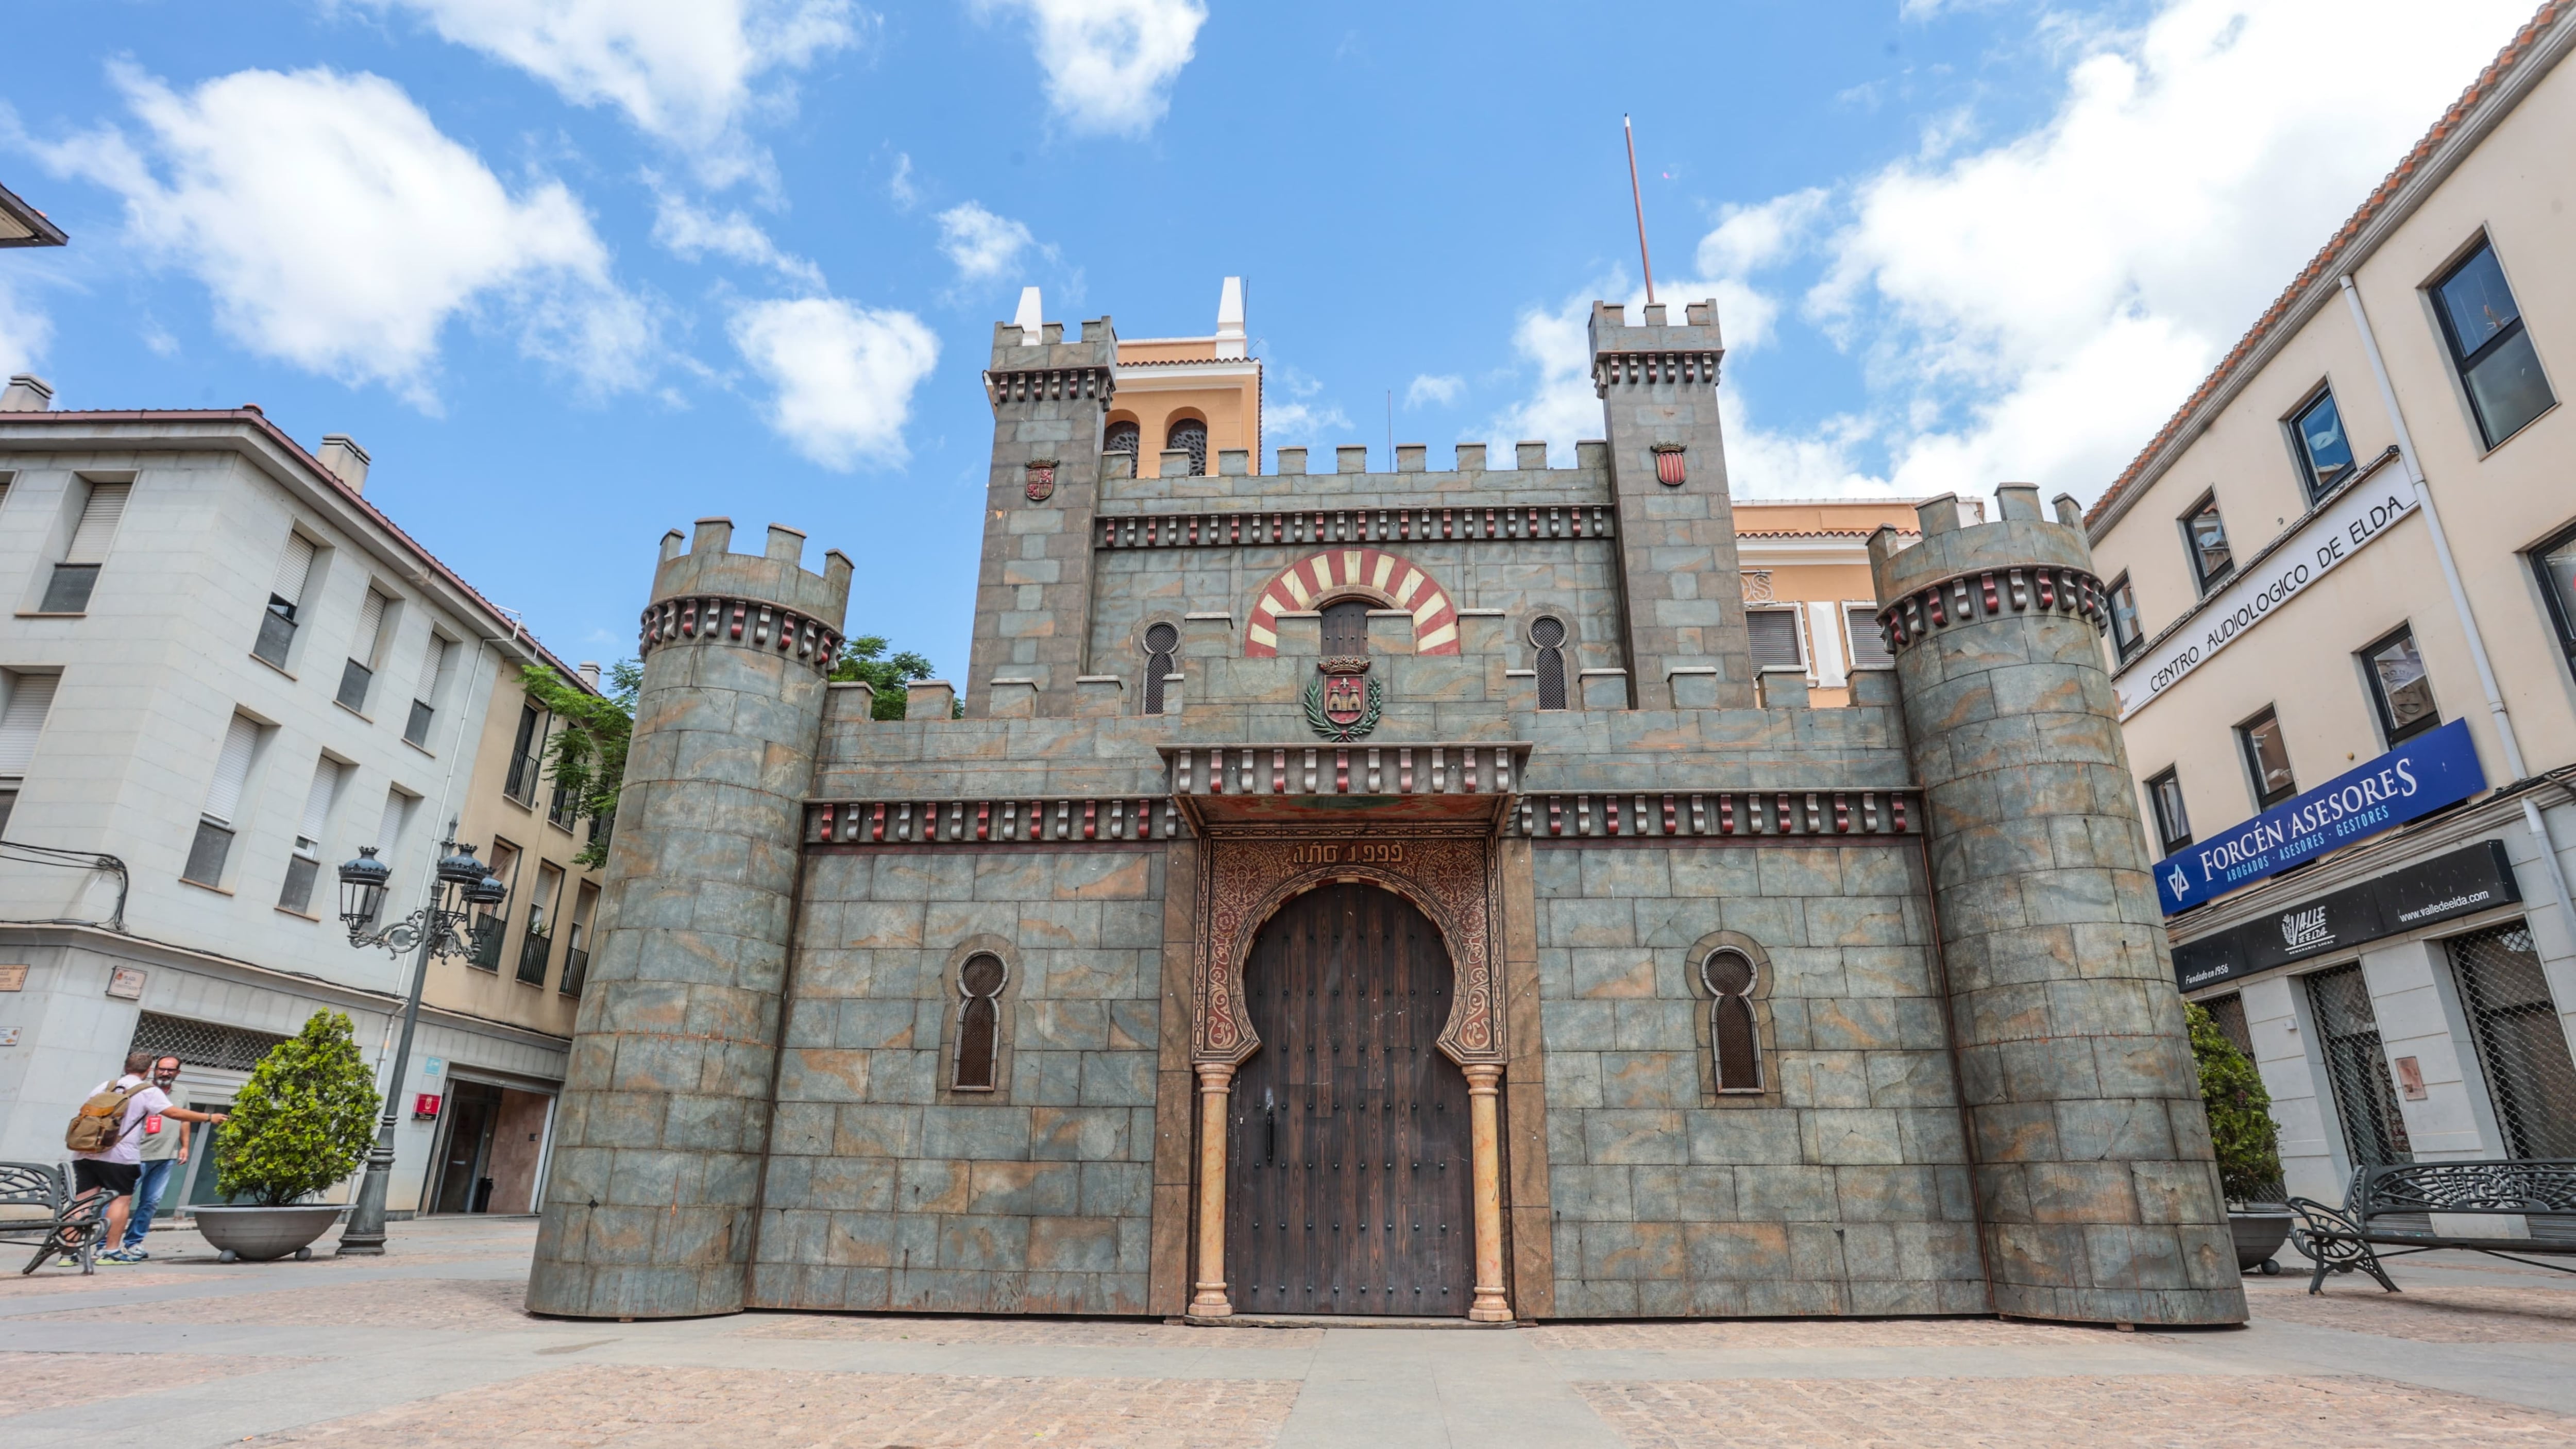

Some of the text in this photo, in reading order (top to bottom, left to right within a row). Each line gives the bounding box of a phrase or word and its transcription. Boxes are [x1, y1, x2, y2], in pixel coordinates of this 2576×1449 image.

[2150, 496, 2404, 692] CENTRO AUDIOLOGICO DE ELDA
[2199, 758, 2417, 882] FORCÉN ASESORES
[2226, 805, 2390, 882] ABOGADOS ASESORES GESTORES
[2291, 906, 2326, 946] VALLE
[2399, 891, 2489, 923] www.valledeelda.com
[2289, 945, 2317, 955] SEMANARIO
[2208, 970, 2214, 978] en
[2214, 963, 2229, 976] 1956
